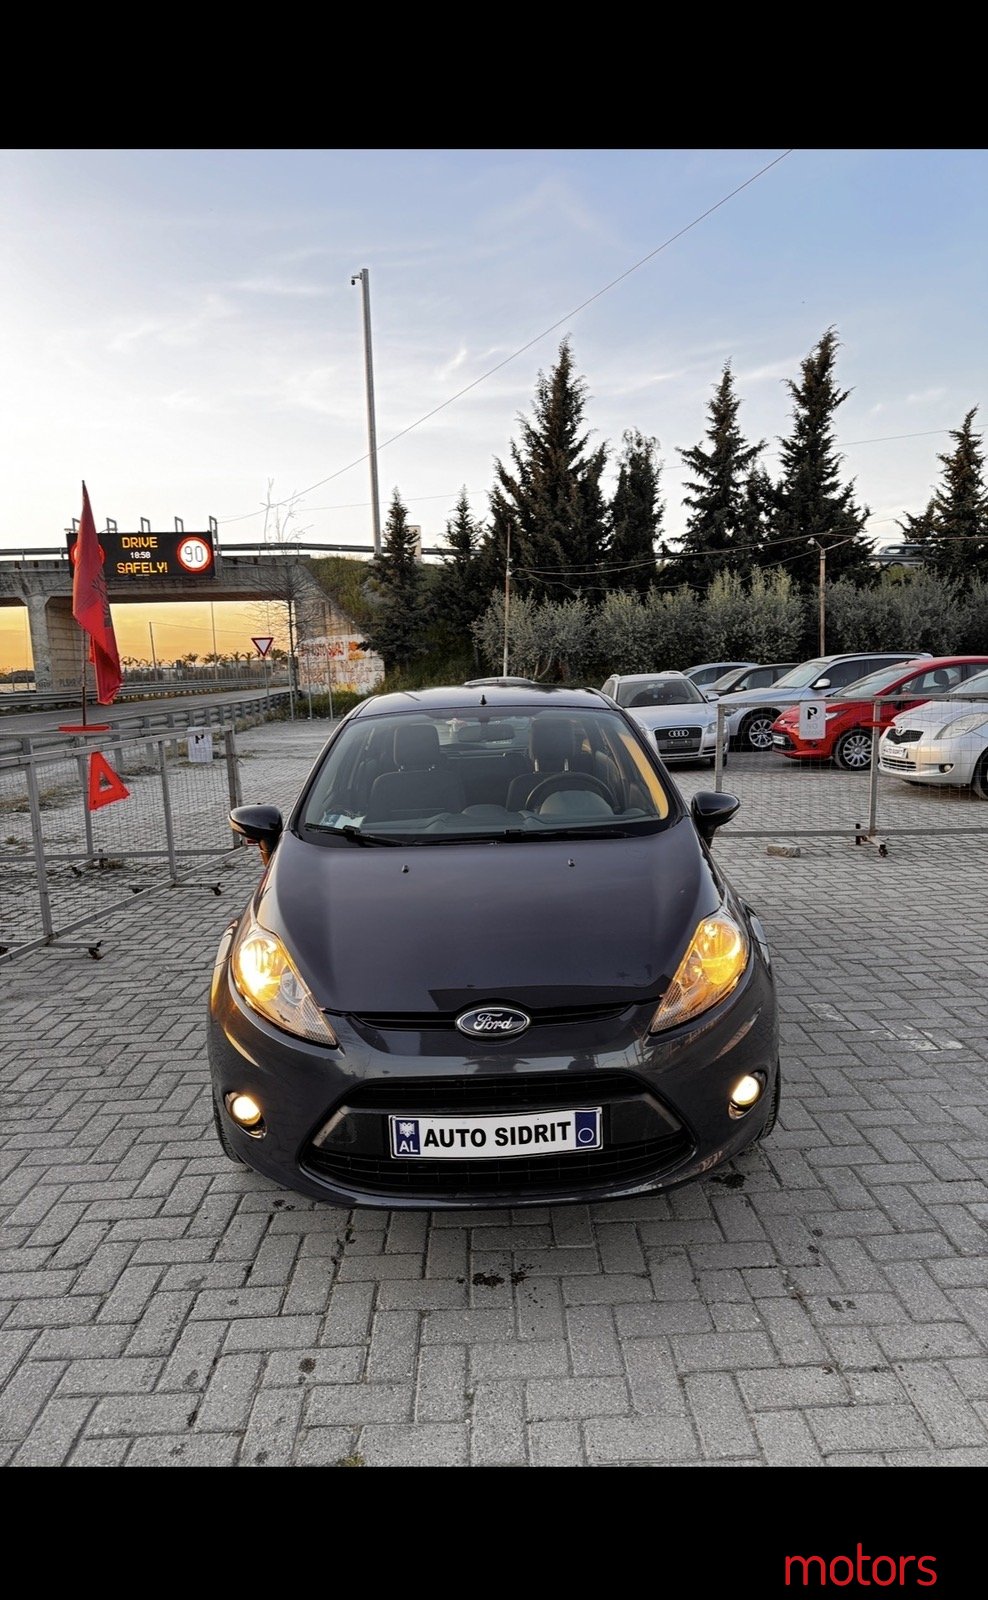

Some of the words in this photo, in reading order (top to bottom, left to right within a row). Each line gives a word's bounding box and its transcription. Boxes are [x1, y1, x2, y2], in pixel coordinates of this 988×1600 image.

[121, 536, 158, 548] DRIVE
[184, 545, 204, 562] 90
[116, 562, 168, 574] SAFELY!
[473, 1012, 514, 1031] Ford
[423, 1128, 487, 1148] AUTO
[494, 1121, 571, 1147] SIDRIT
[399, 1140, 418, 1153] AL
